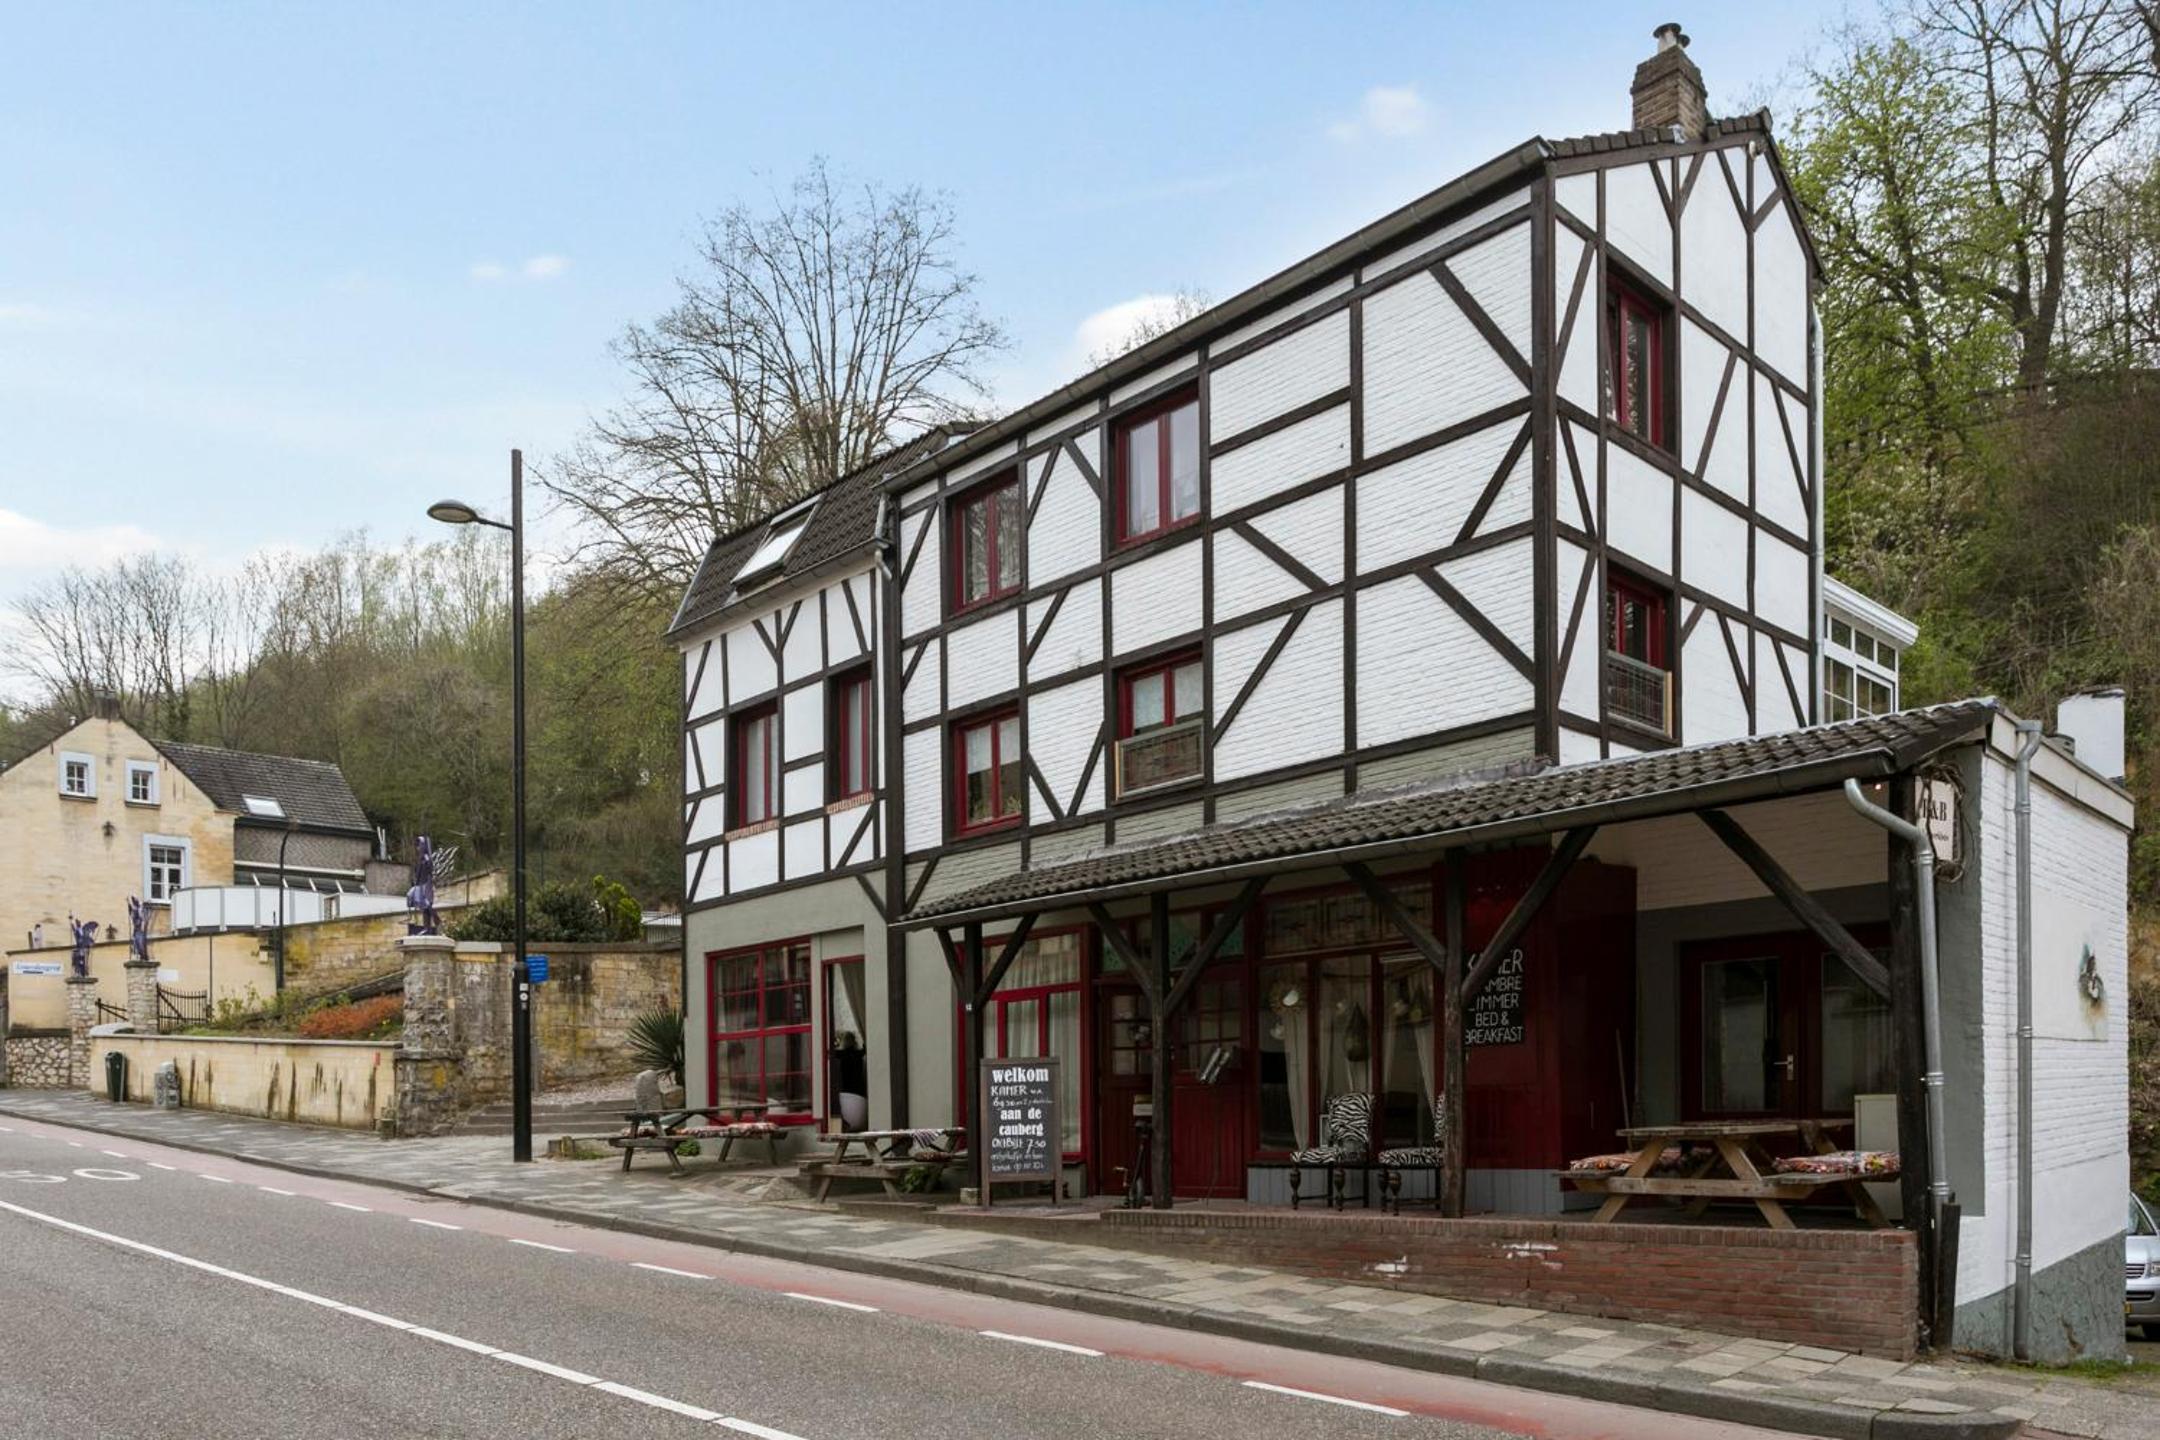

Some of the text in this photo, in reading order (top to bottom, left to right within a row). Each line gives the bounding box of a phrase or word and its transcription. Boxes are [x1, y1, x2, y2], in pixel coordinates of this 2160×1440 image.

[1475, 1011, 1509, 1027] BED &
[1465, 1026, 1523, 1045] BREAKFAST
[992, 1067, 1049, 1083] welkom
[1000, 1107, 1042, 1121] aan de
[999, 1123, 1044, 1137] cauberg
